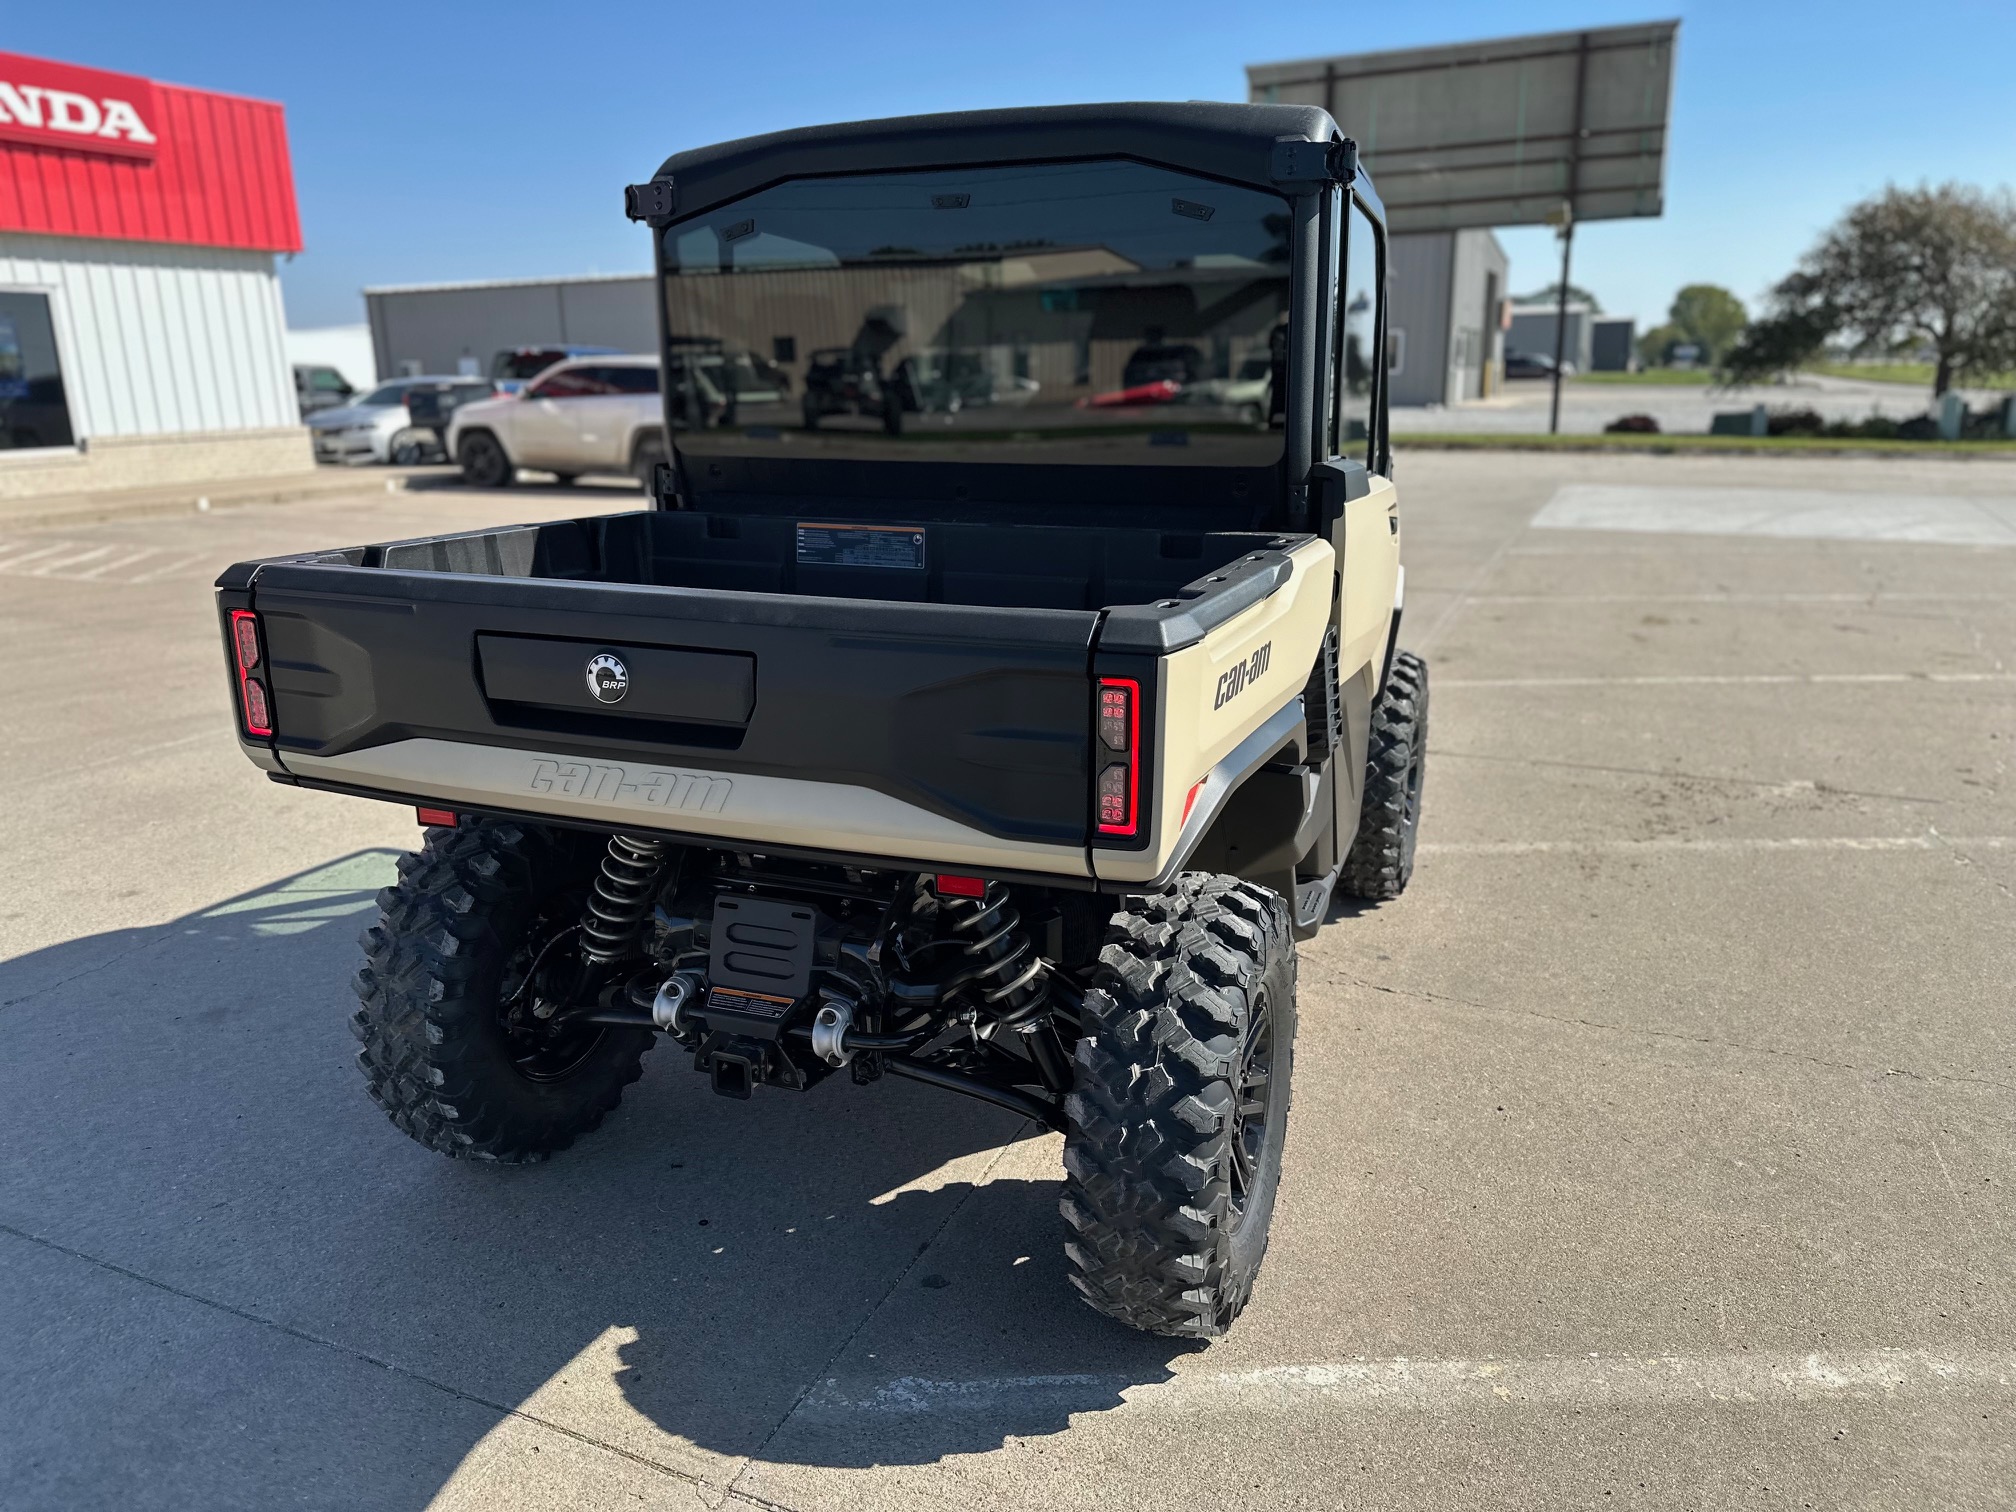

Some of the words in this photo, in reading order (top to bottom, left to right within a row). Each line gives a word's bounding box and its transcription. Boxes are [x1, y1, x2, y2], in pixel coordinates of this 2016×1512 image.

[602, 680, 626, 690] BRP
[1214, 640, 1272, 711] can-am
[530, 758, 733, 813] can-am
